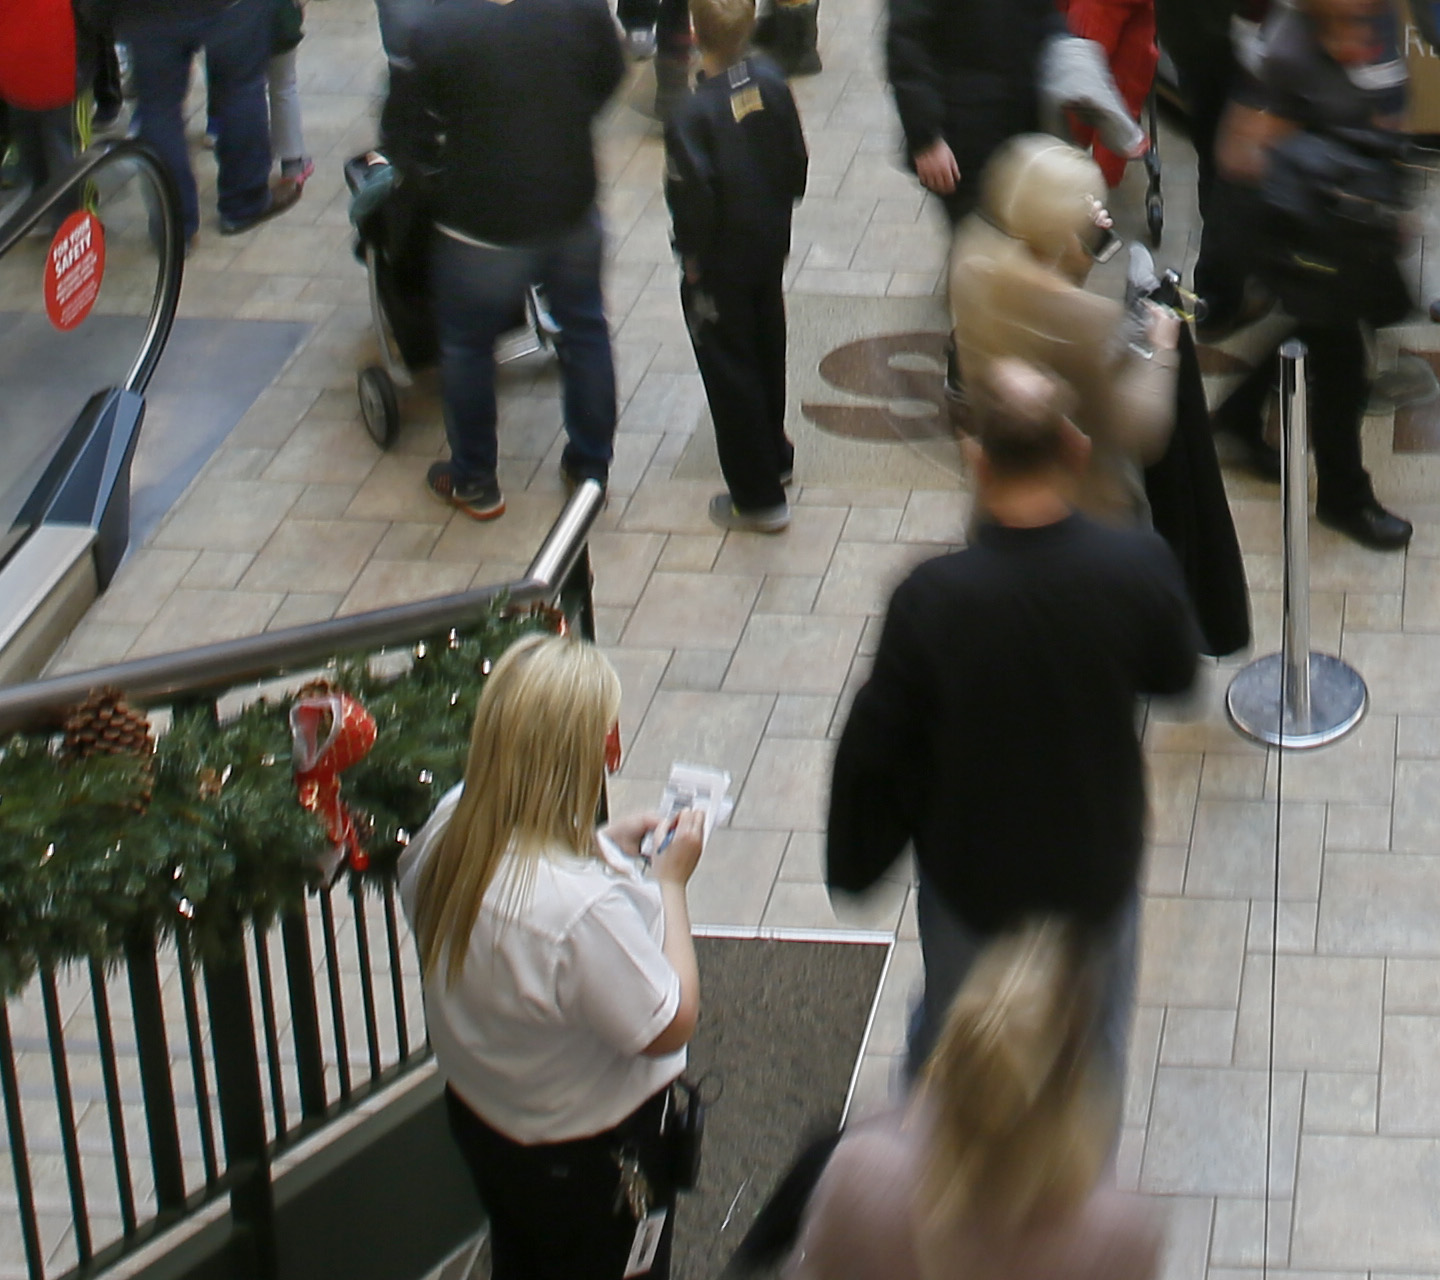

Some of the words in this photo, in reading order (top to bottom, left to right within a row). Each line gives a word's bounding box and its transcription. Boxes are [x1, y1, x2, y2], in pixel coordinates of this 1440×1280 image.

[53, 238, 69, 263] FOR
[70, 215, 90, 246] YOUR
[55, 229, 92, 279] SAFETY
